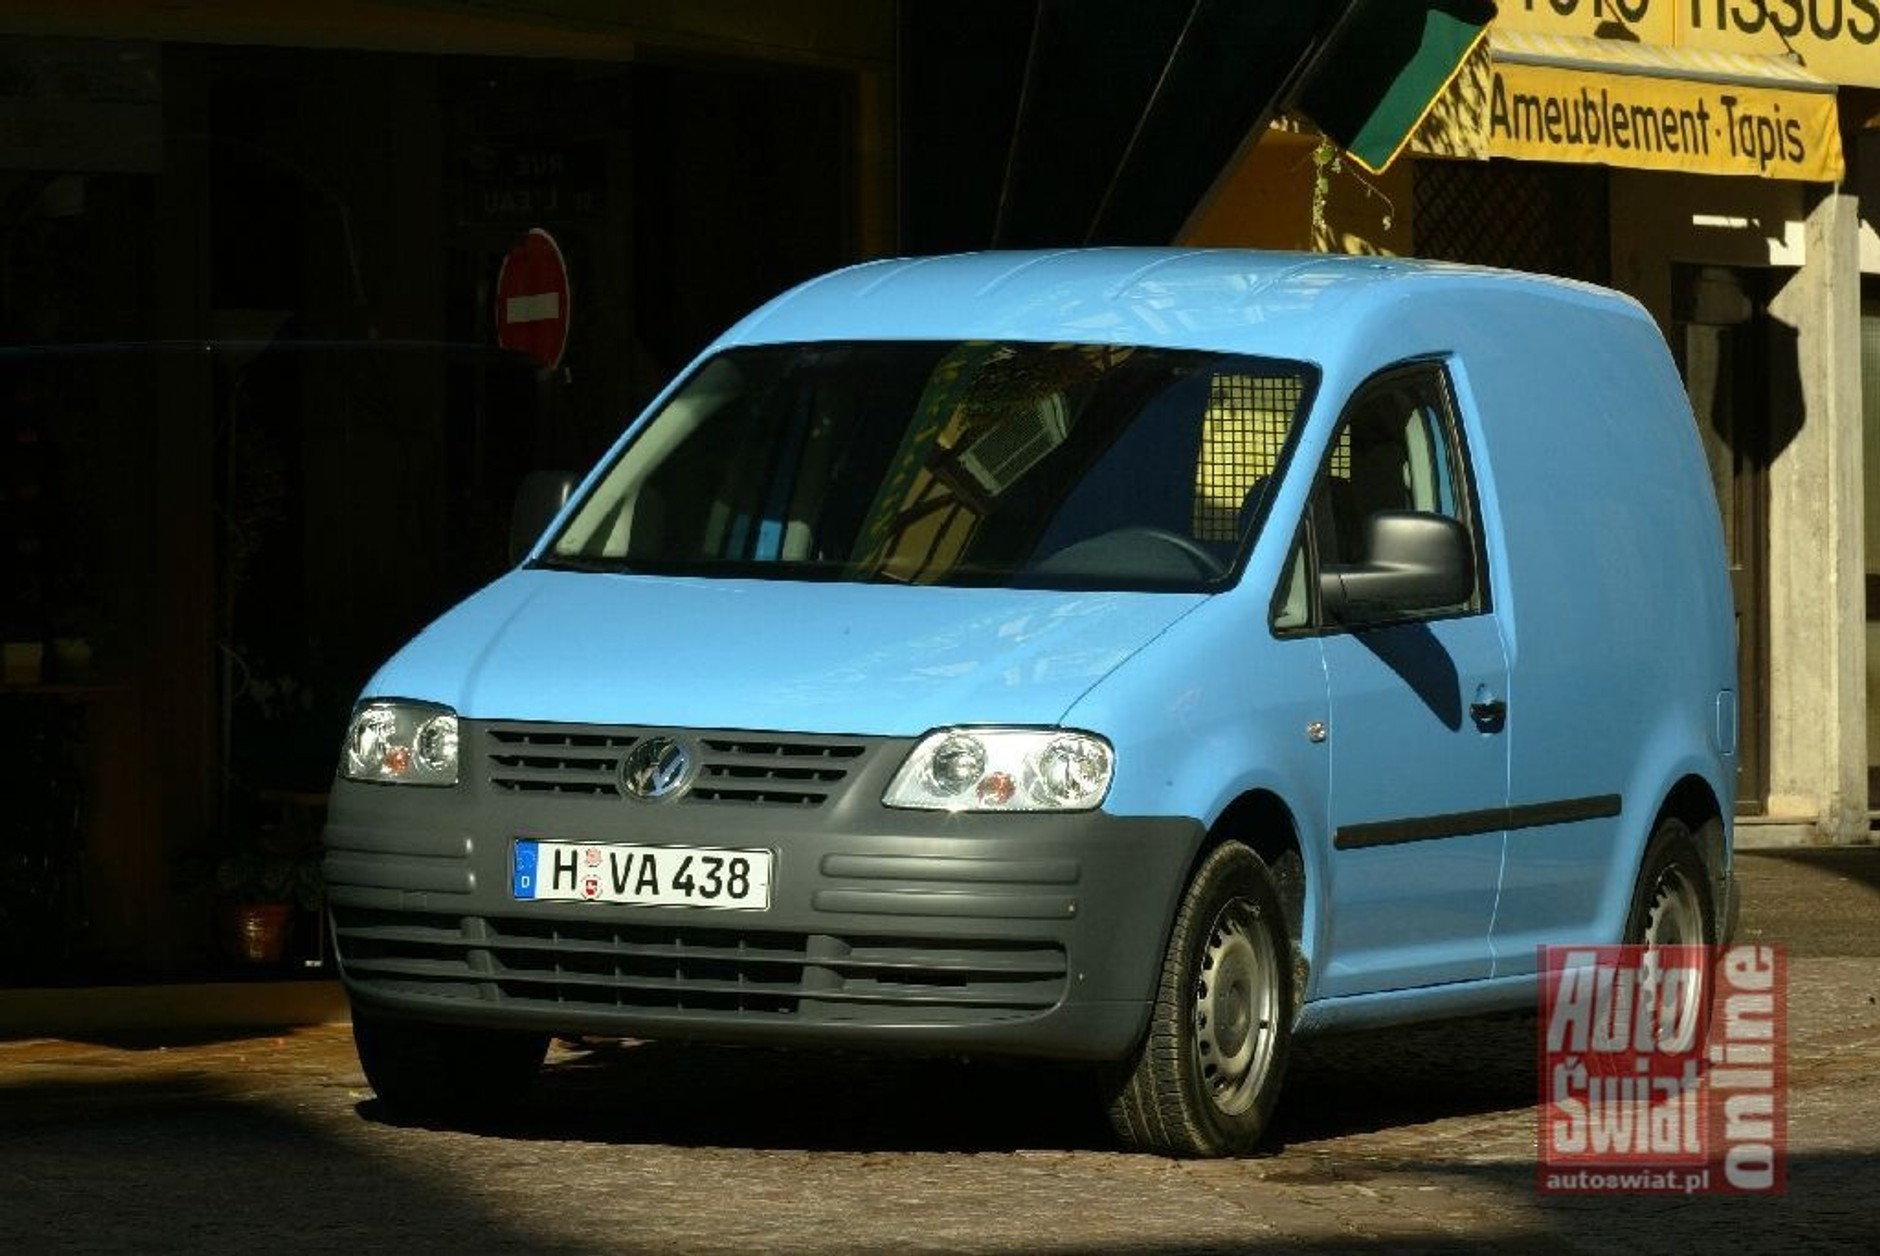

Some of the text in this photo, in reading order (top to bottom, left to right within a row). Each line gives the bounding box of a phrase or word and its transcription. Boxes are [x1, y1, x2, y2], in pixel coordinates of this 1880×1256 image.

[1490, 73, 1806, 169] Ameublement Tapis
[552, 848, 751, 899] H VA 438
